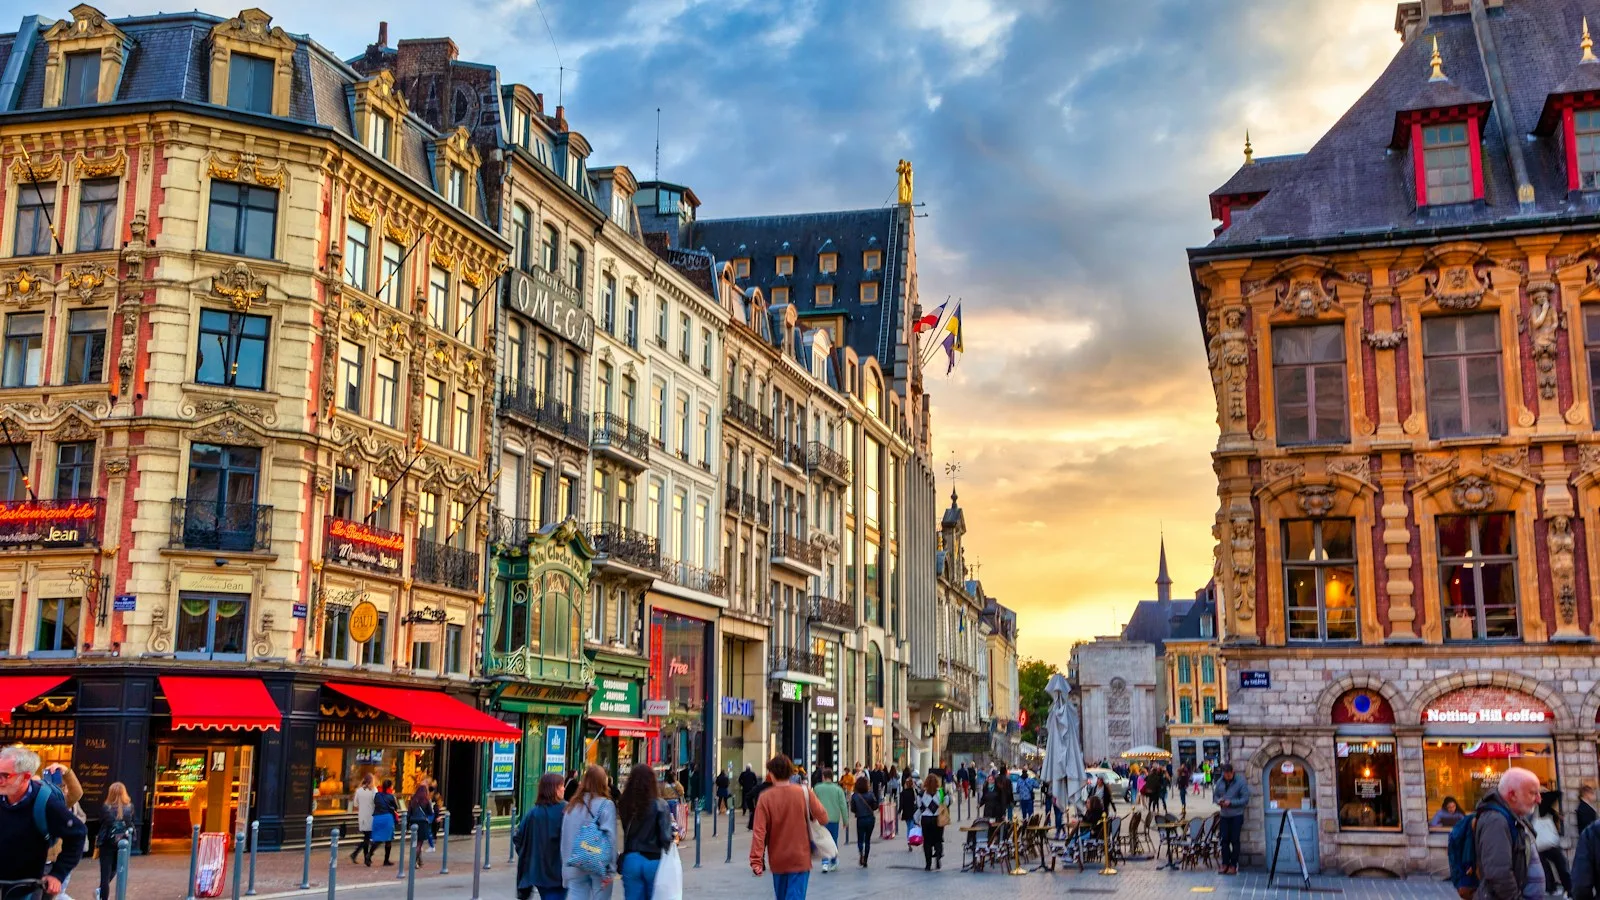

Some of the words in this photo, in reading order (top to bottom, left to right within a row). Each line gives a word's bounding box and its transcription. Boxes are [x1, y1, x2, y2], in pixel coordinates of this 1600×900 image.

[518, 276, 589, 348] OMEGA
[44, 526, 79, 541] Jean
[378, 552, 397, 569] Jean
[221, 582, 244, 590] Jean
[352, 612, 375, 629] PAUL
[668, 657, 688, 678] free
[1427, 709, 1477, 724] Notting
[1479, 709, 1502, 722] Hill
[1504, 709, 1545, 722] coffee
[1376, 744, 1392, 753] Hill
